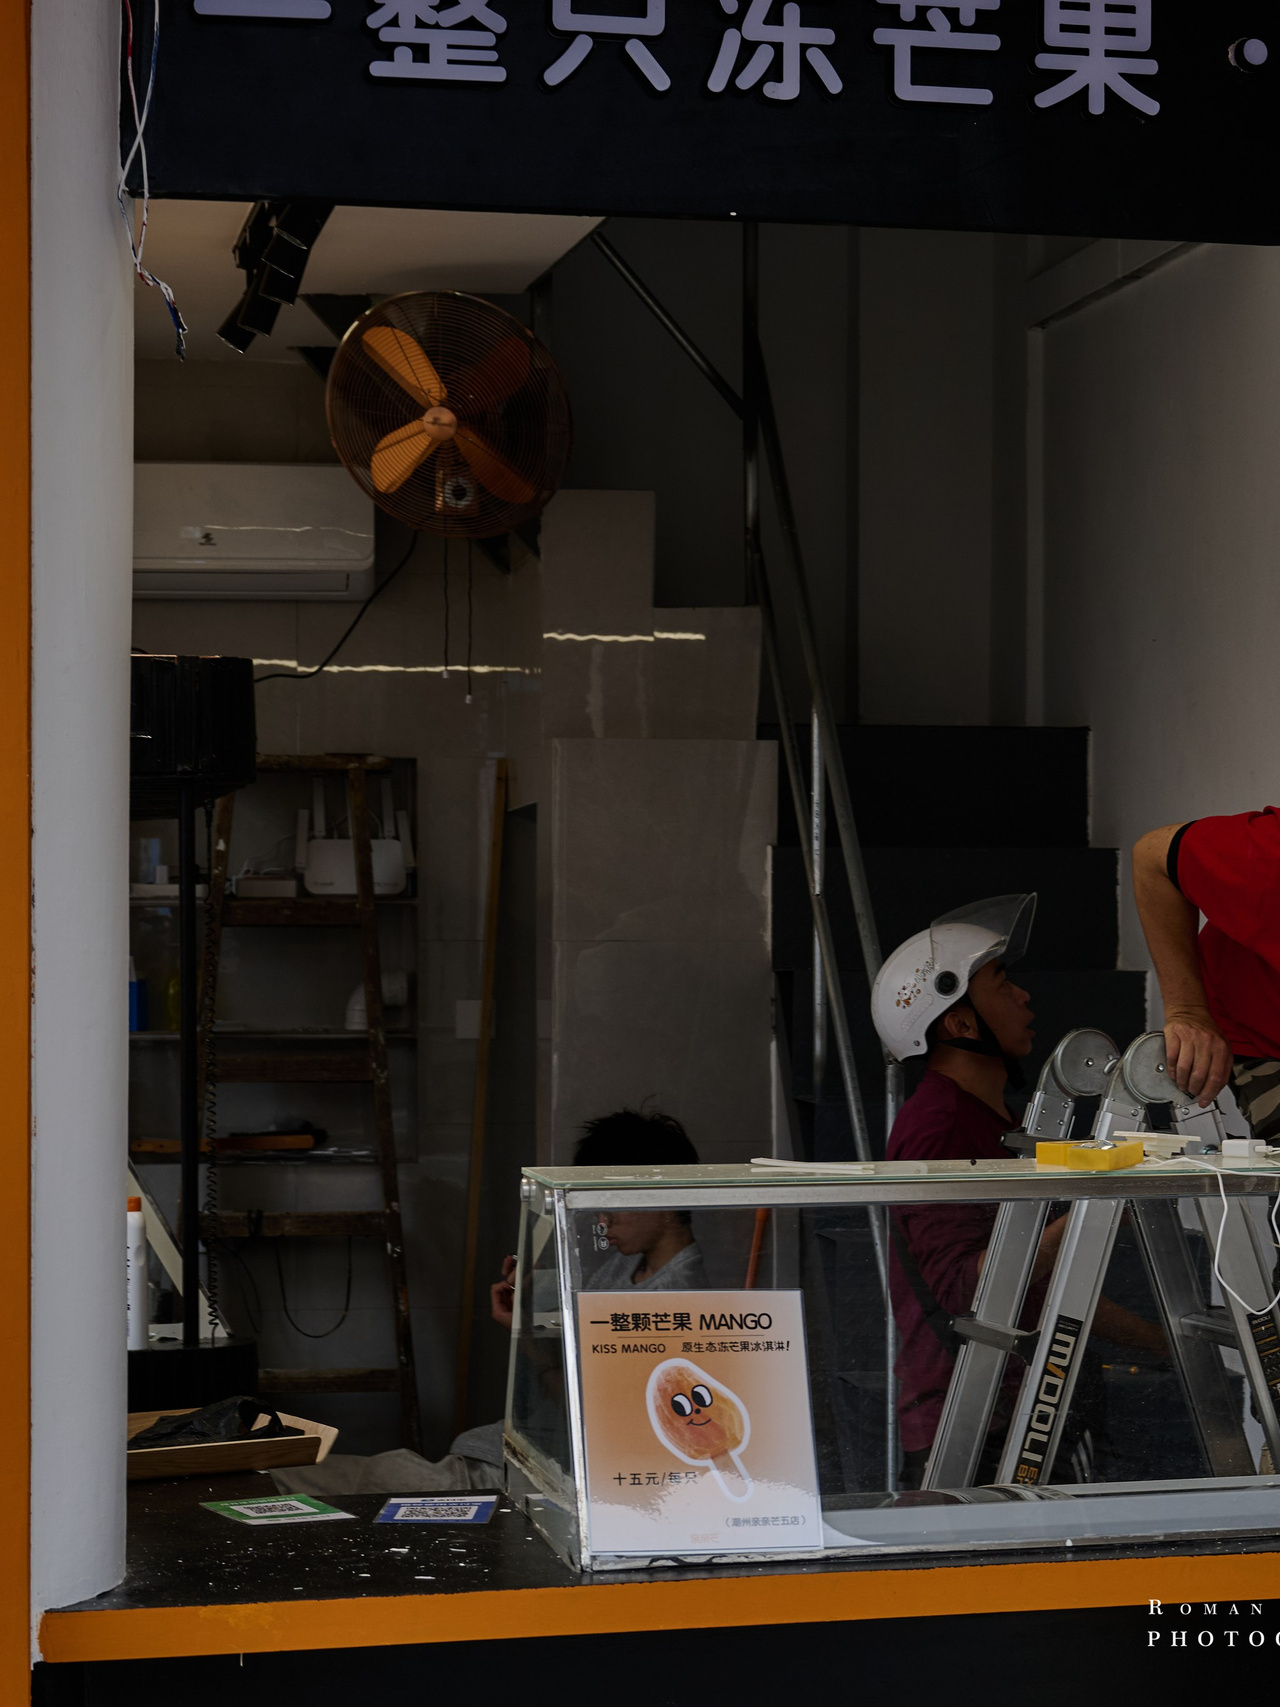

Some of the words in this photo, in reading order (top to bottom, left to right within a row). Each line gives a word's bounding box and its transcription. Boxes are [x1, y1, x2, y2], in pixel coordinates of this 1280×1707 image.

[590, 1312, 693, 1332] 一整颗芒果
[699, 1312, 773, 1331] MANGO
[592, 1344, 617, 1354] KISS
[621, 1343, 666, 1354] MANGO
